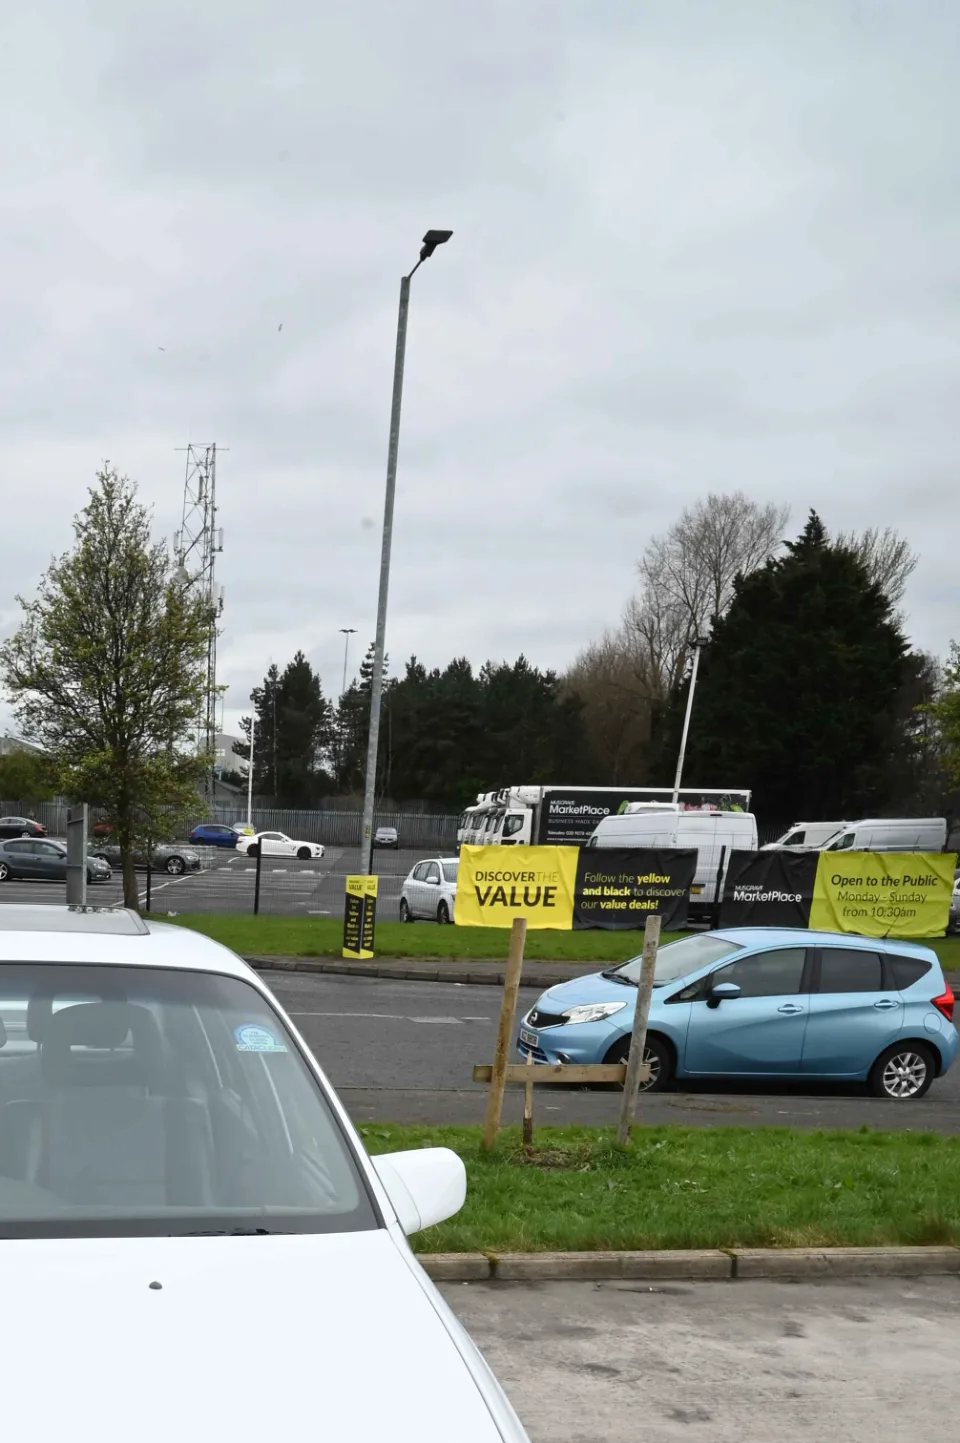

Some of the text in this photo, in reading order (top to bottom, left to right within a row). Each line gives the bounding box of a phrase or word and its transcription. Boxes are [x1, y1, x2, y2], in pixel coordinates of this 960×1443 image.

[549, 805, 610, 815] MarketPlace
[475, 871, 559, 882] DISCOVER THE
[584, 872, 670, 884] Follow the yellow
[831, 874, 938, 887] Open to the Public
[474, 885, 557, 907] VALUE
[582, 886, 601, 896] and
[603, 886, 630, 896] black
[634, 887, 643, 897] to
[646, 887, 686, 897] discover
[733, 890, 802, 903] MarketPlace
[838, 891, 880, 903] Monday
[889, 891, 927, 904] Sunday
[581, 898, 659, 909] our value deals!
[842, 907, 916, 917] from 10:30am
